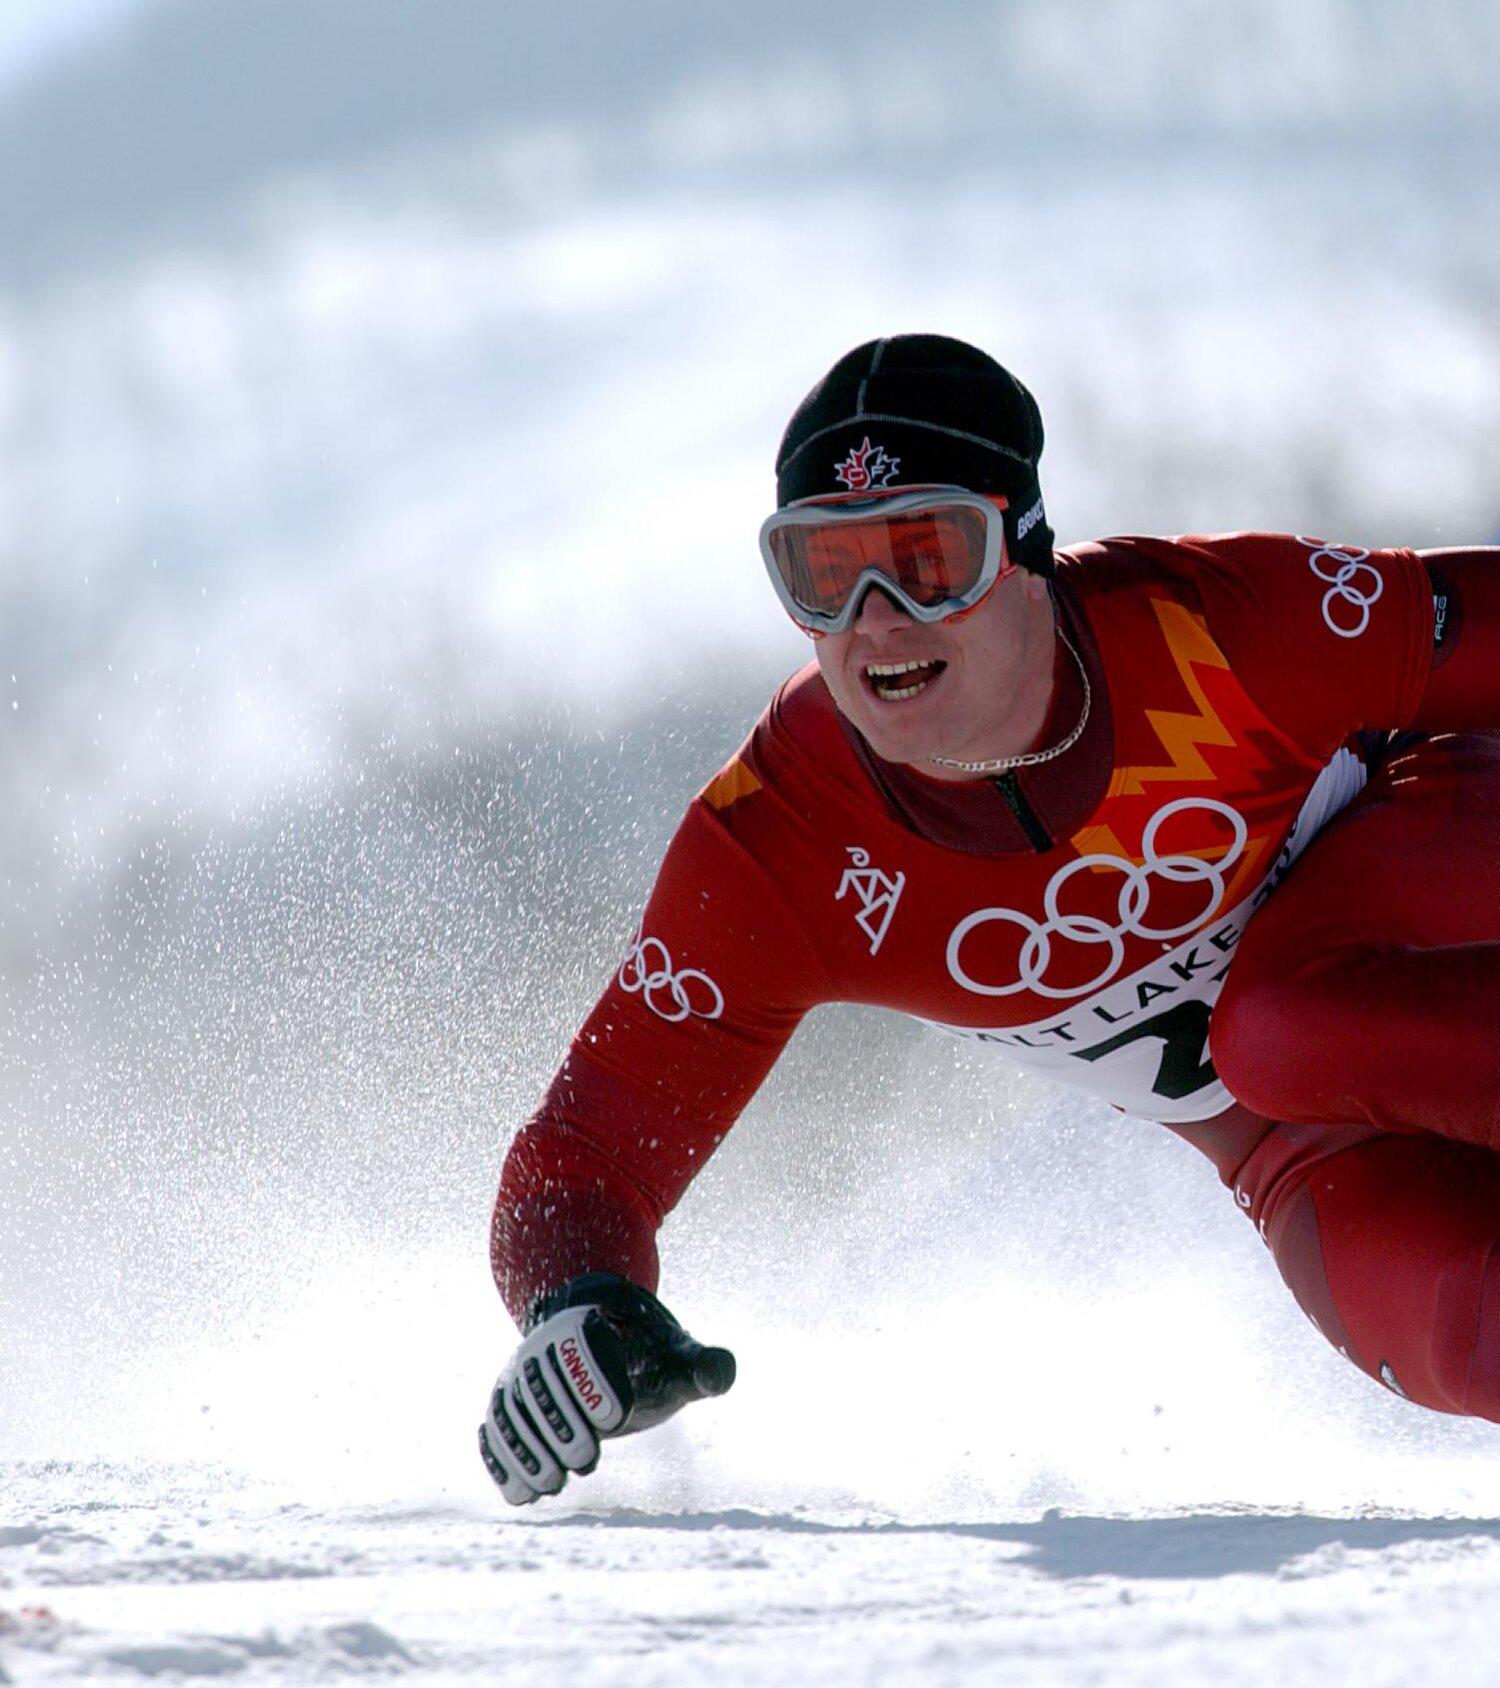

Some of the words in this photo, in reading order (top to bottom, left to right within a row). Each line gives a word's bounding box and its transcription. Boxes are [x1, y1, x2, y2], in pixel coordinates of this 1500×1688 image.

[1434, 596, 1448, 641] ACG
[1092, 922, 1240, 1024] LAKE
[1068, 963, 1231, 1100] 2
[559, 1337, 604, 1411] CANADA
